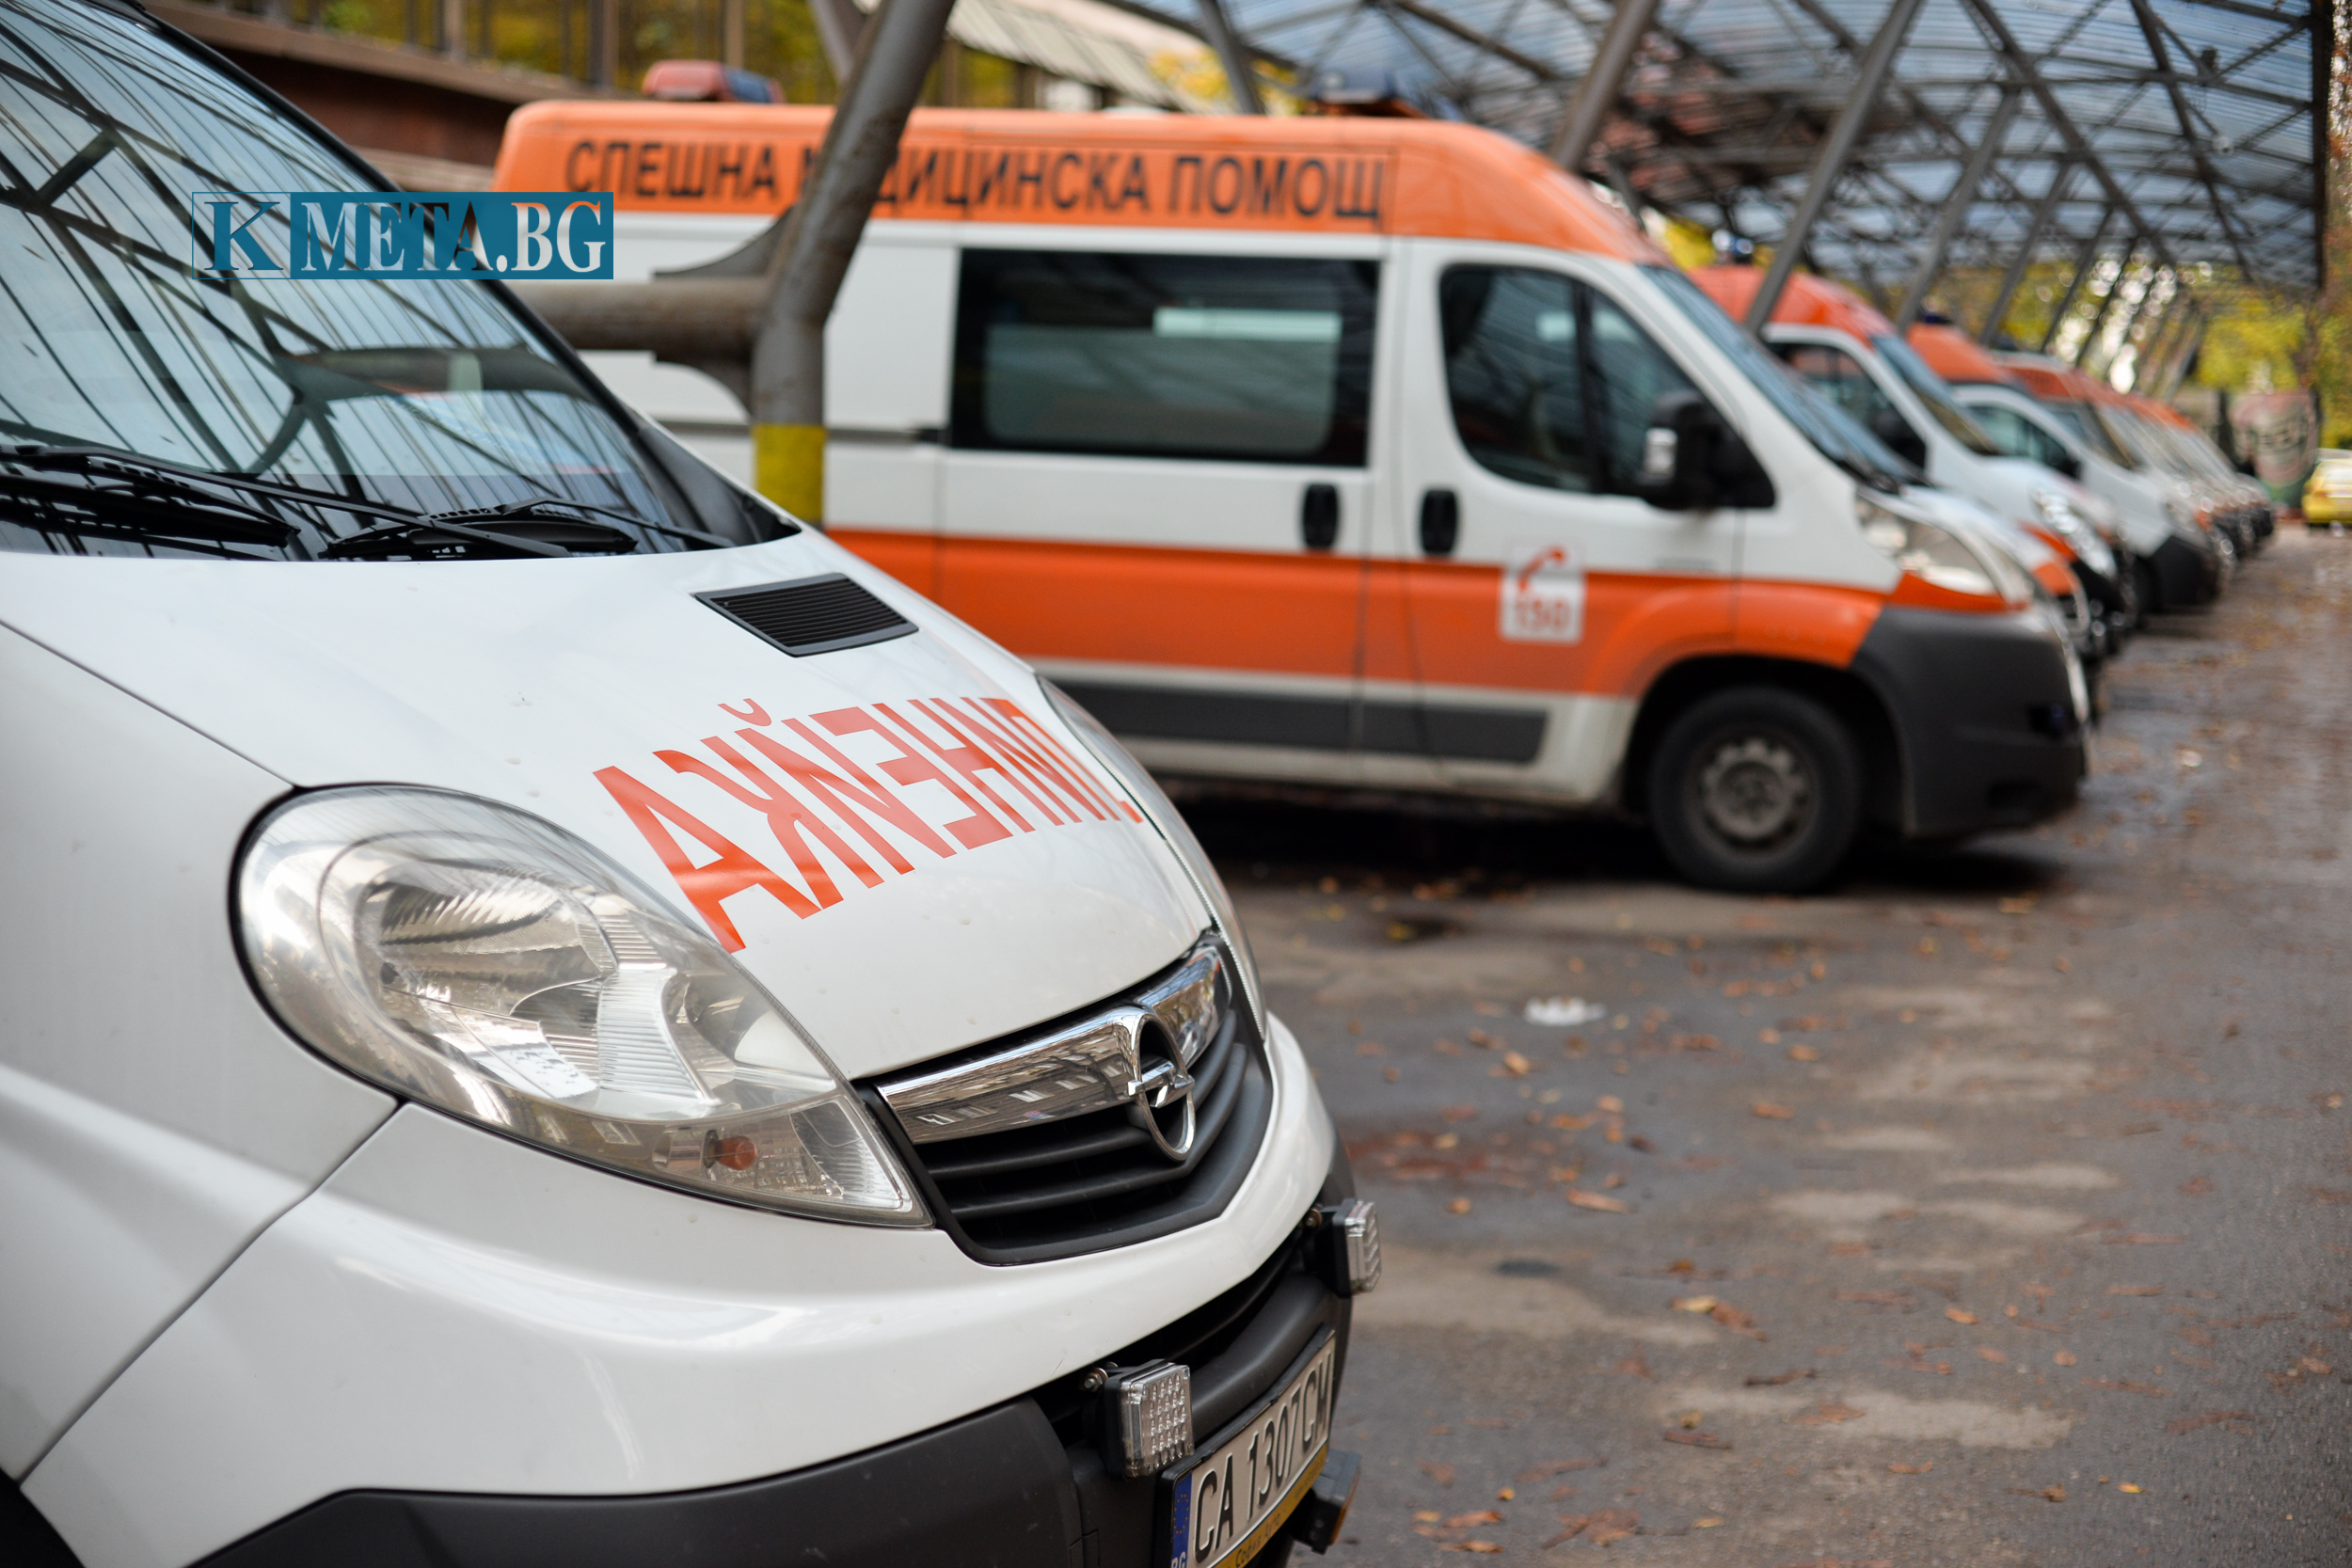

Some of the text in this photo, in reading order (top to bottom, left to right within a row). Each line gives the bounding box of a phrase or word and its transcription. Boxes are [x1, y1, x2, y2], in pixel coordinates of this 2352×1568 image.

[565, 141, 780, 200] СПЕШНА
[1168, 154, 1388, 233] ПОМОЩ
[1194, 1452, 1233, 1564] CA
